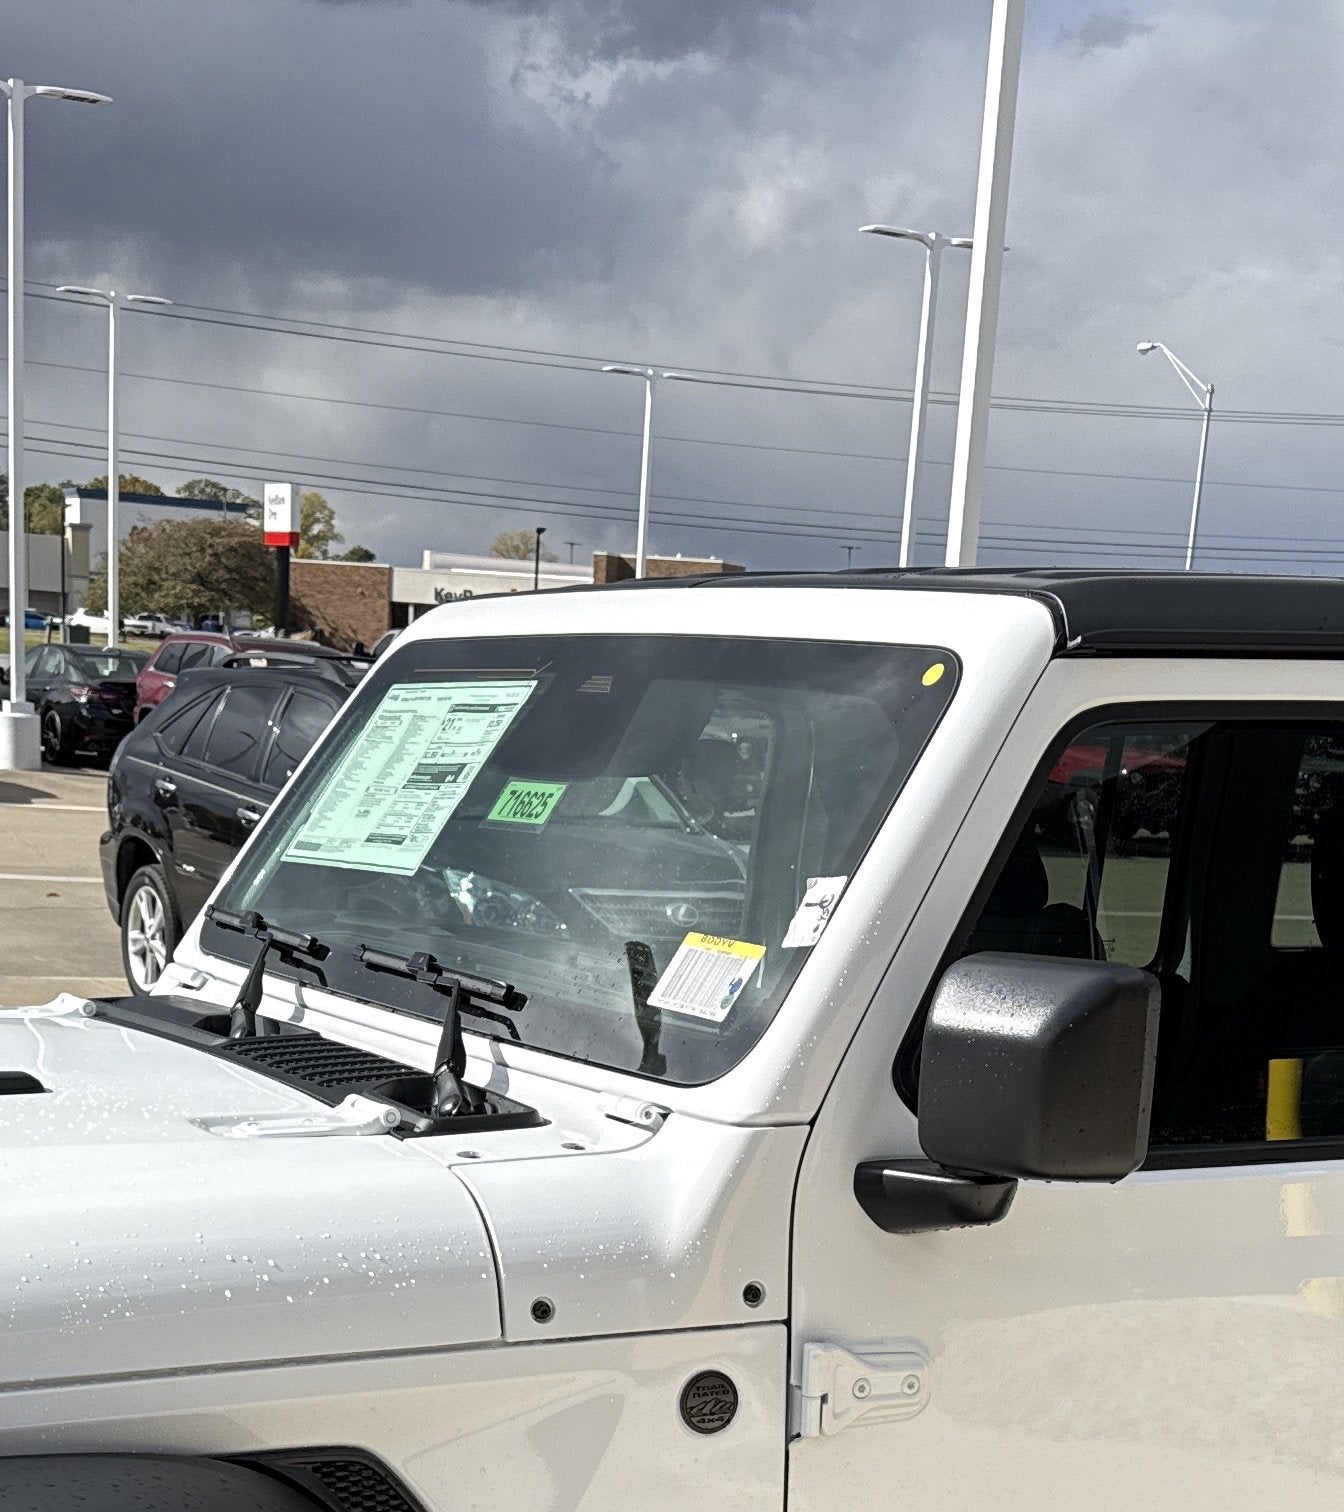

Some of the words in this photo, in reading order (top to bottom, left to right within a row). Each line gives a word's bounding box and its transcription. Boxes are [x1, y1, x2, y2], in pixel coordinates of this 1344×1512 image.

[435, 586, 473, 604] KeyB
[497, 789, 554, 819] 716625
[692, 1389, 730, 1399] RATED
[696, 1384, 727, 1392] TRAIL
